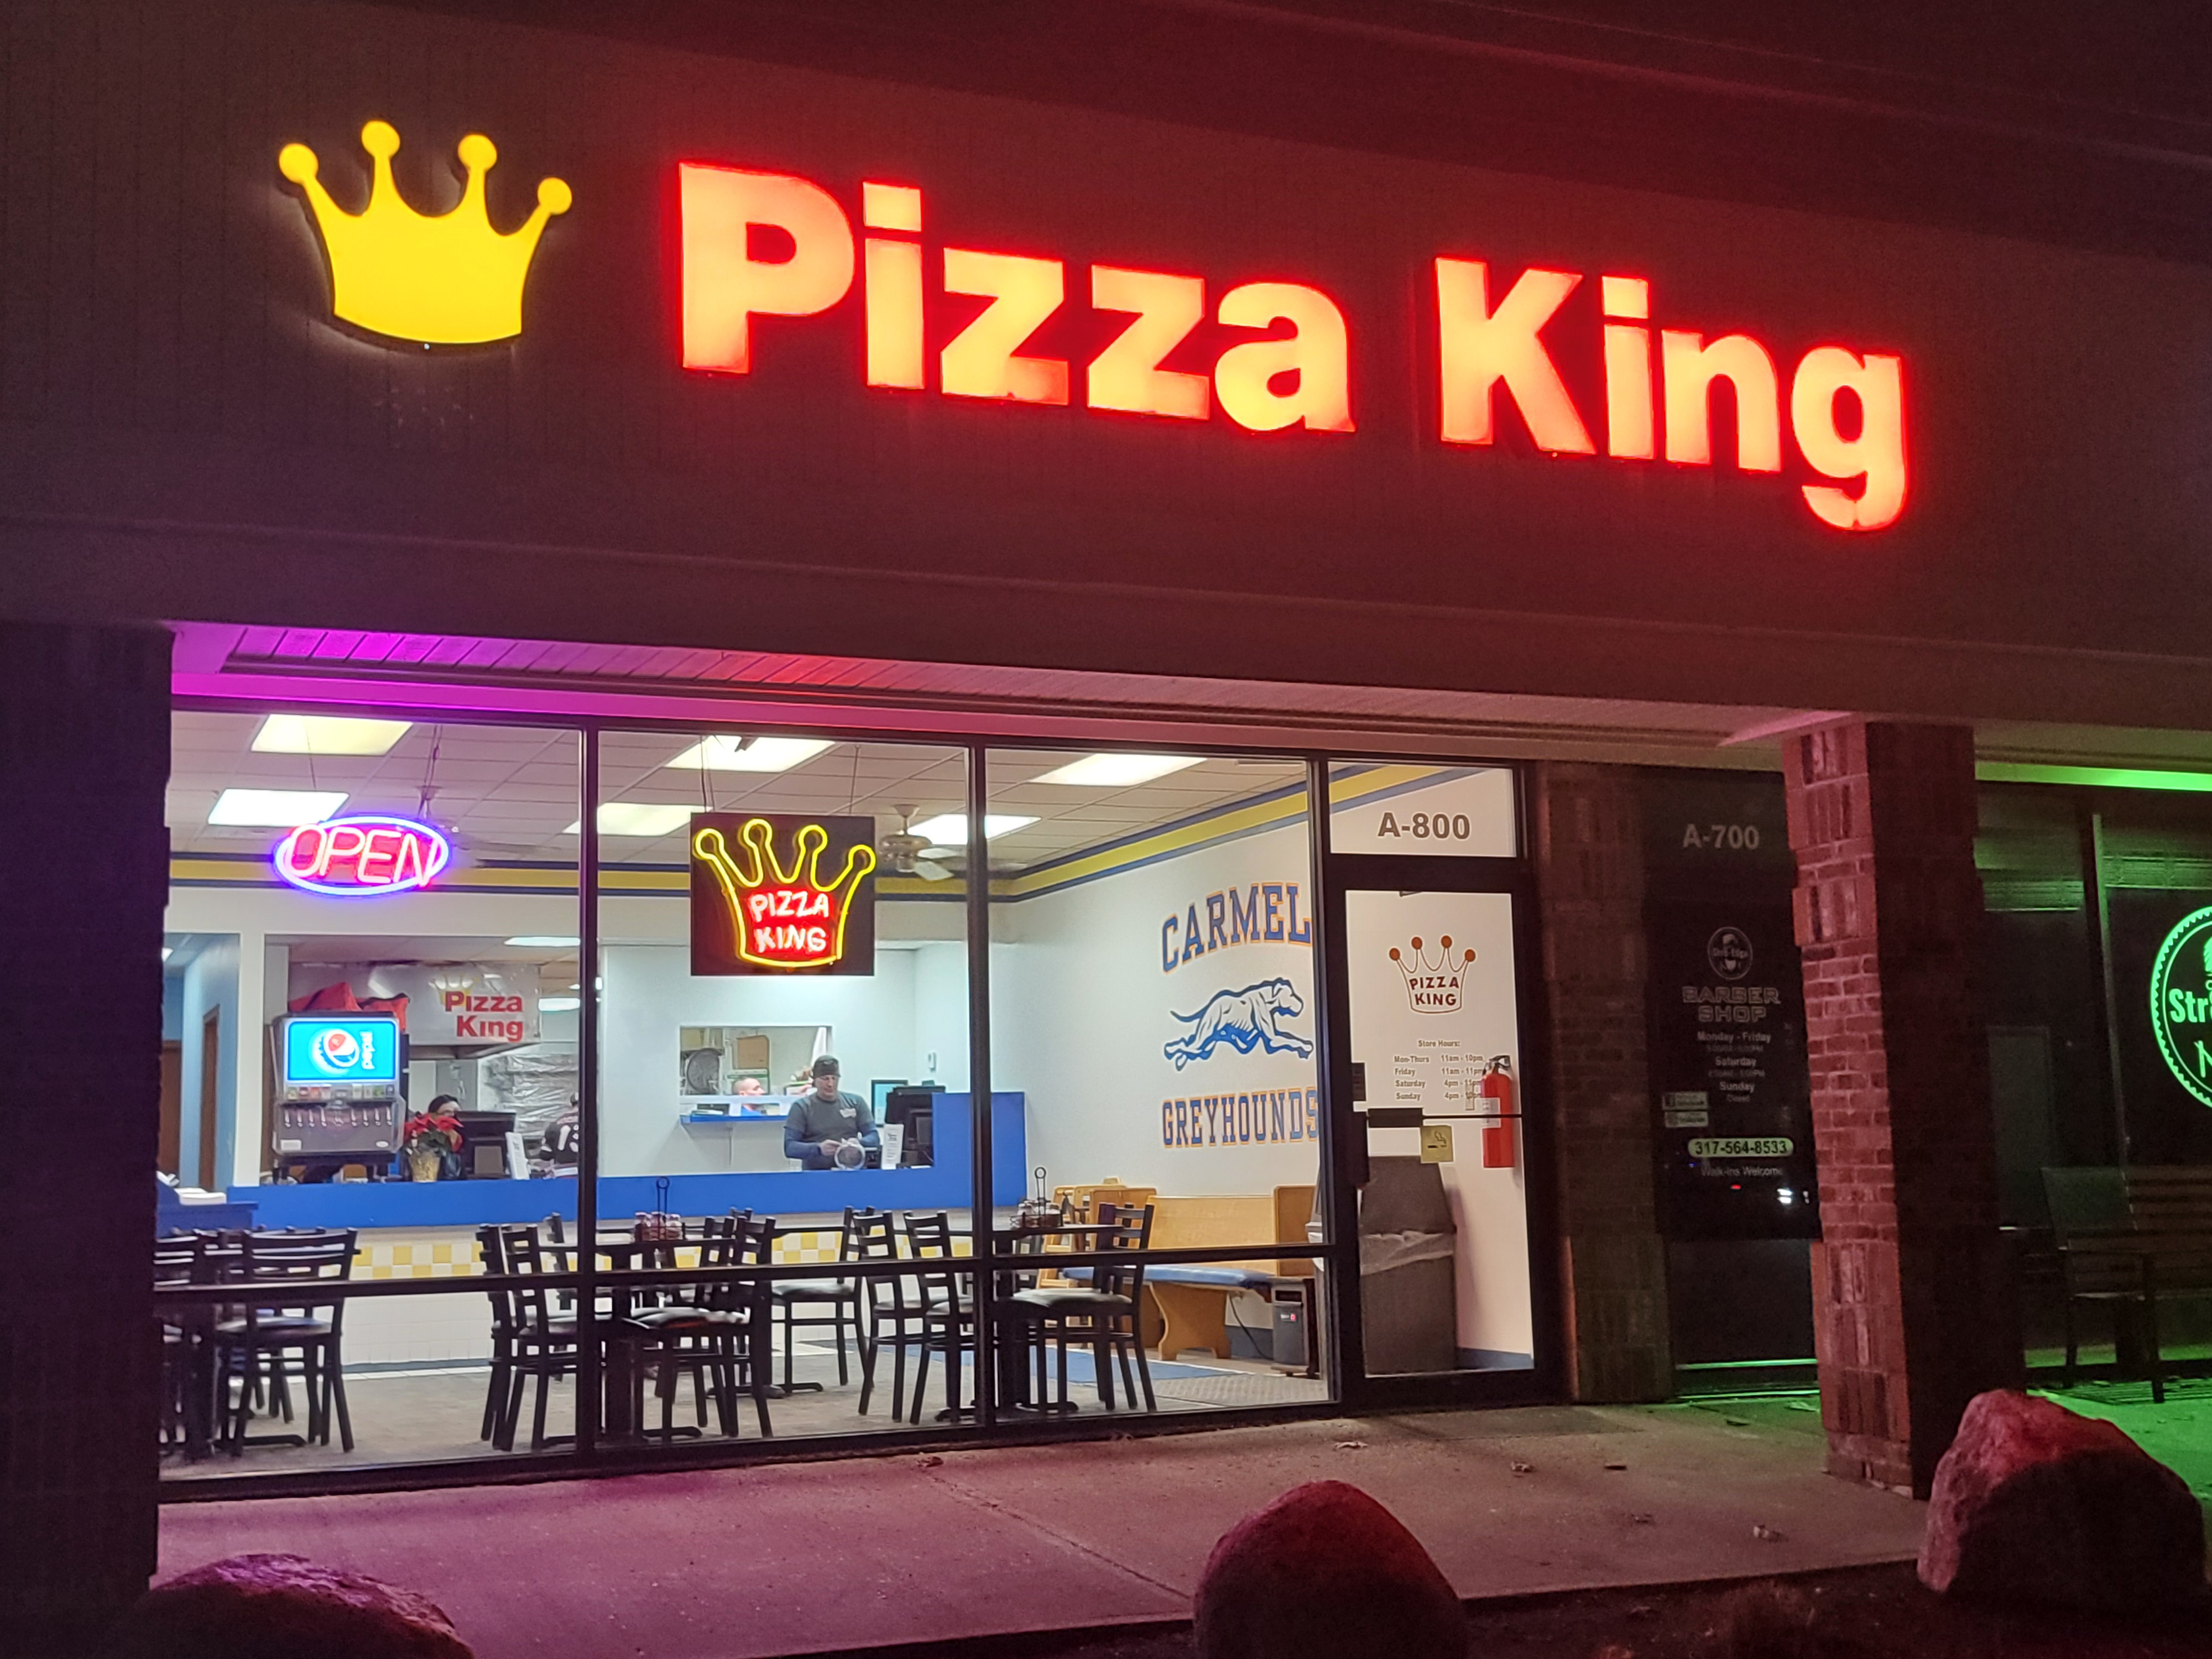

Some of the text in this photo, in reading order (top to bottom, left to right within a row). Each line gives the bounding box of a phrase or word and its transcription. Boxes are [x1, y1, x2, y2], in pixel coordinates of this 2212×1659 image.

[679, 163, 1906, 530] Pizza King
[1378, 812, 1470, 840] A-800
[1683, 823, 1759, 849] A-700
[284, 823, 439, 887] OPEN
[749, 890, 829, 922] PIZZA
[1162, 882, 1313, 973] CARMEL
[754, 925, 826, 953] KING
[1409, 976, 1459, 990] PIZZA
[445, 991, 523, 1012] Pizza
[1415, 993, 1457, 1006] KING
[1682, 986, 1781, 1004] BARBER
[1698, 1005, 1766, 1022] SHOP
[2169, 988, 2212, 1023] Str
[457, 1015, 523, 1042] King
[1697, 1031, 1734, 1044] Monday
[1743, 1031, 1771, 1044] Friday
[1465, 1054, 1483, 1062] 10pm
[1715, 1056, 1756, 1067] Saturday
[1395, 1068, 1416, 1077] Friday
[1395, 1079, 1426, 1088] Saturday
[1444, 1079, 1458, 1088] 4pm
[1719, 1081, 1755, 1093] Sunday
[1396, 1092, 1421, 1100] Sunday
[1444, 1092, 1459, 1100] 4pm
[1162, 1087, 1318, 1148] GREYHOUNDS
[1694, 1140, 1787, 1155] 317-564-8533
